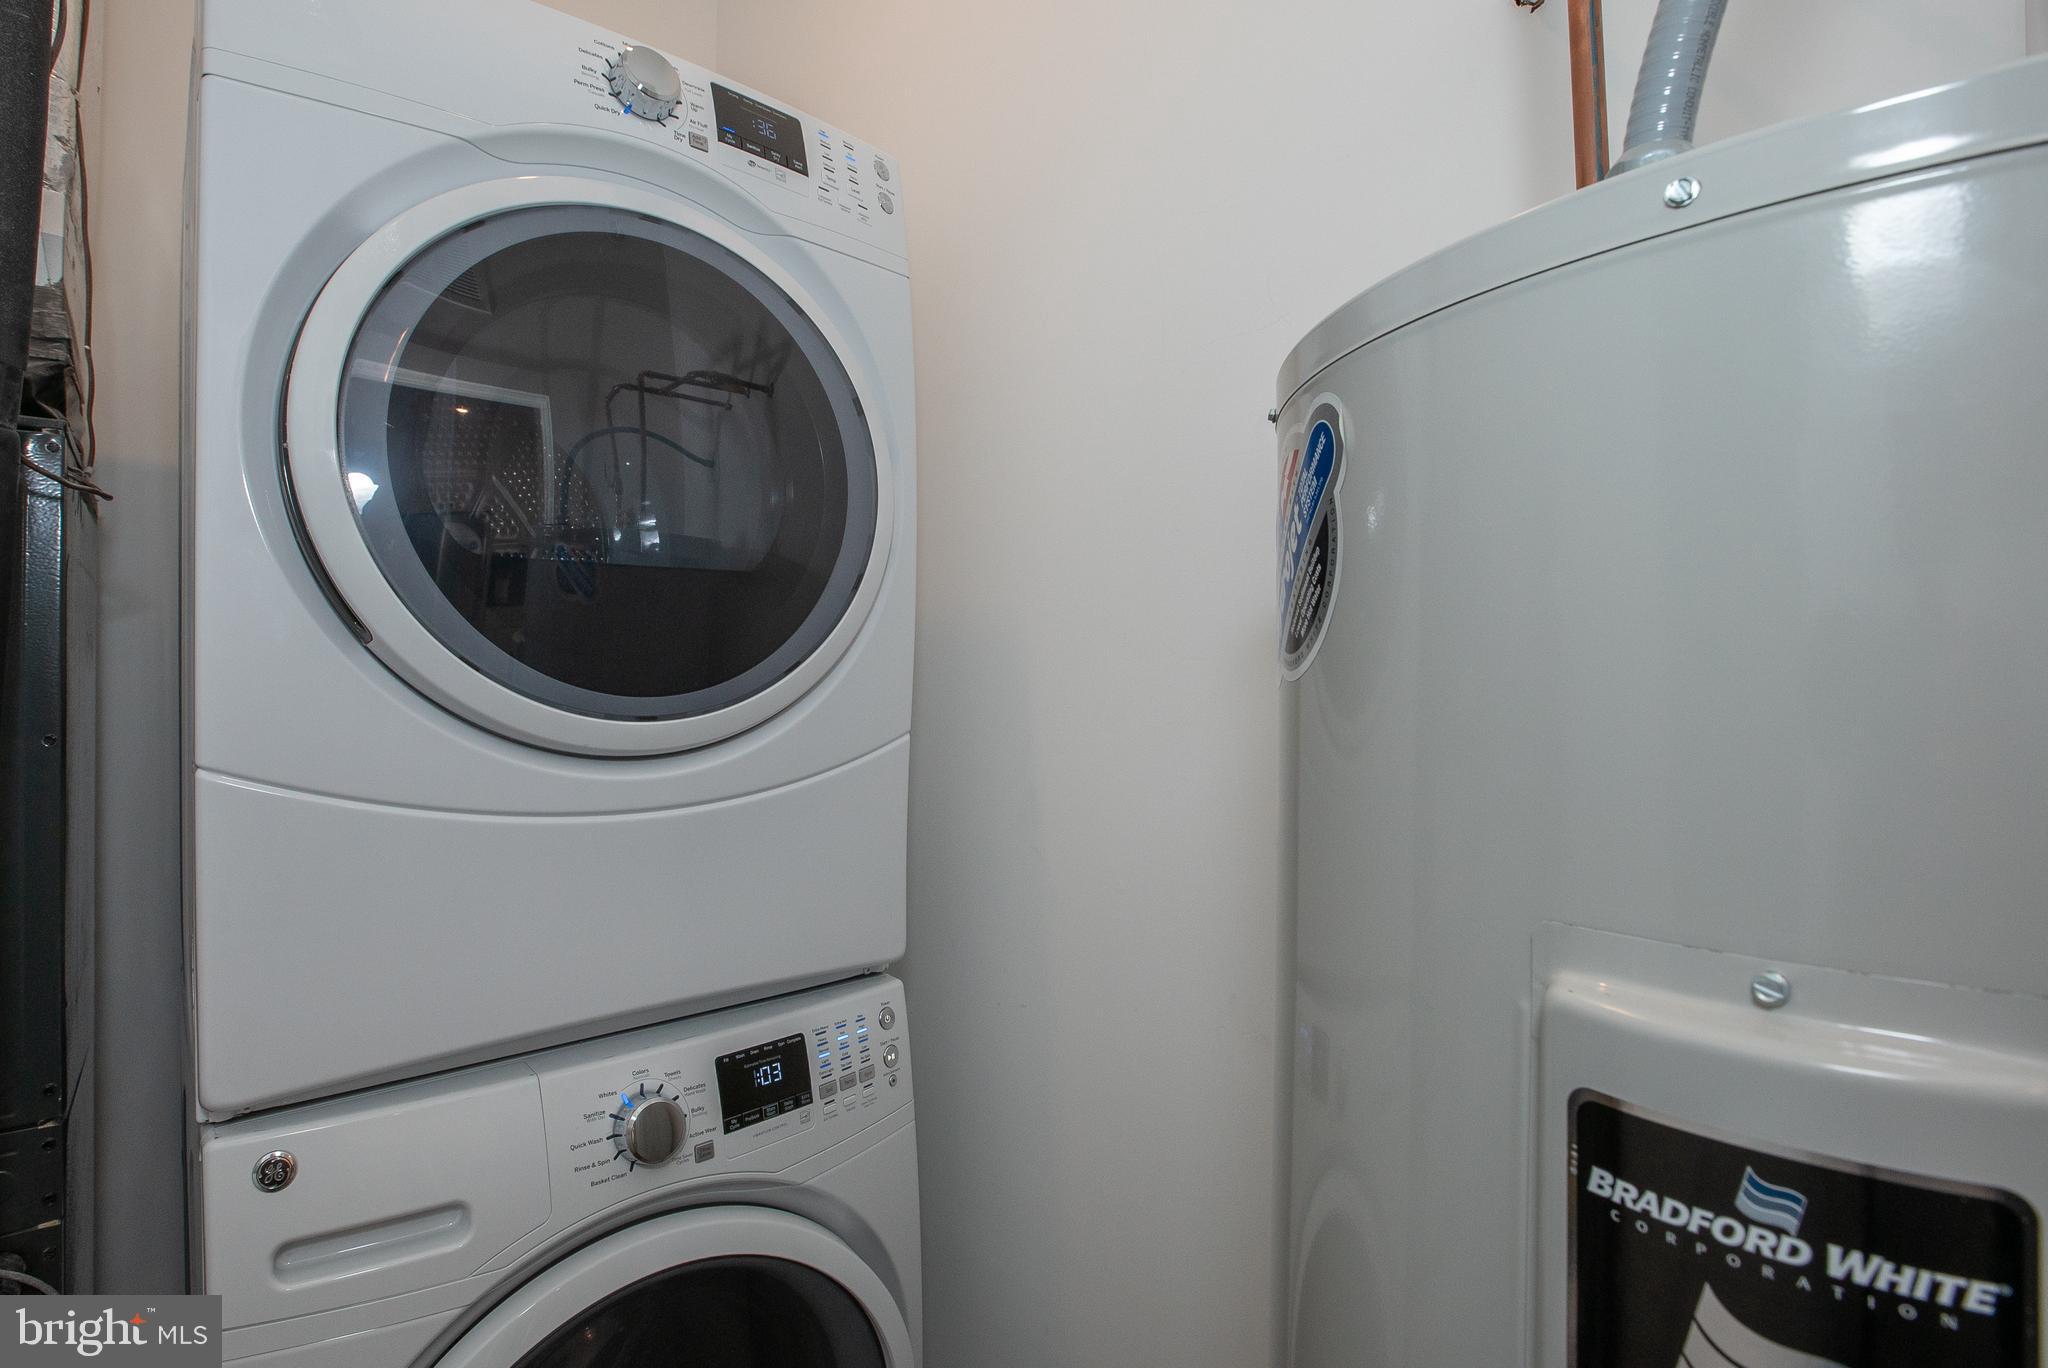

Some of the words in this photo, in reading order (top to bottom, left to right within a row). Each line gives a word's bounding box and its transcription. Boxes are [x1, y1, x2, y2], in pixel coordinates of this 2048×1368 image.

[578, 47, 603, 60] Delicates
[573, 79, 589, 88] Perm
[594, 103, 610, 113] Quick
[610, 107, 621, 116] Dry
[631, 1068, 650, 1077] Colors
[664, 1069, 682, 1078] Towels
[753, 1062, 782, 1088] 1:03
[683, 1083, 706, 1093] Delicates
[598, 1091, 618, 1100] Whites
[583, 1109, 606, 1120] Sanitize
[691, 1105, 705, 1114] Bulky
[689, 1130, 704, 1139] Active
[704, 1127, 717, 1135] Wear
[569, 1140, 587, 1152] Quick
[587, 1137, 604, 1147] Wash
[574, 1164, 590, 1173] Rinse
[597, 1159, 611, 1169] Spin
[590, 1177, 610, 1187] Basket
[611, 1172, 628, 1181] Clean
[1585, 1165, 1814, 1268] BRADFORD
[1825, 1242, 2002, 1317] WHITE
[1610, 1208, 1960, 1331] CORPORATION
